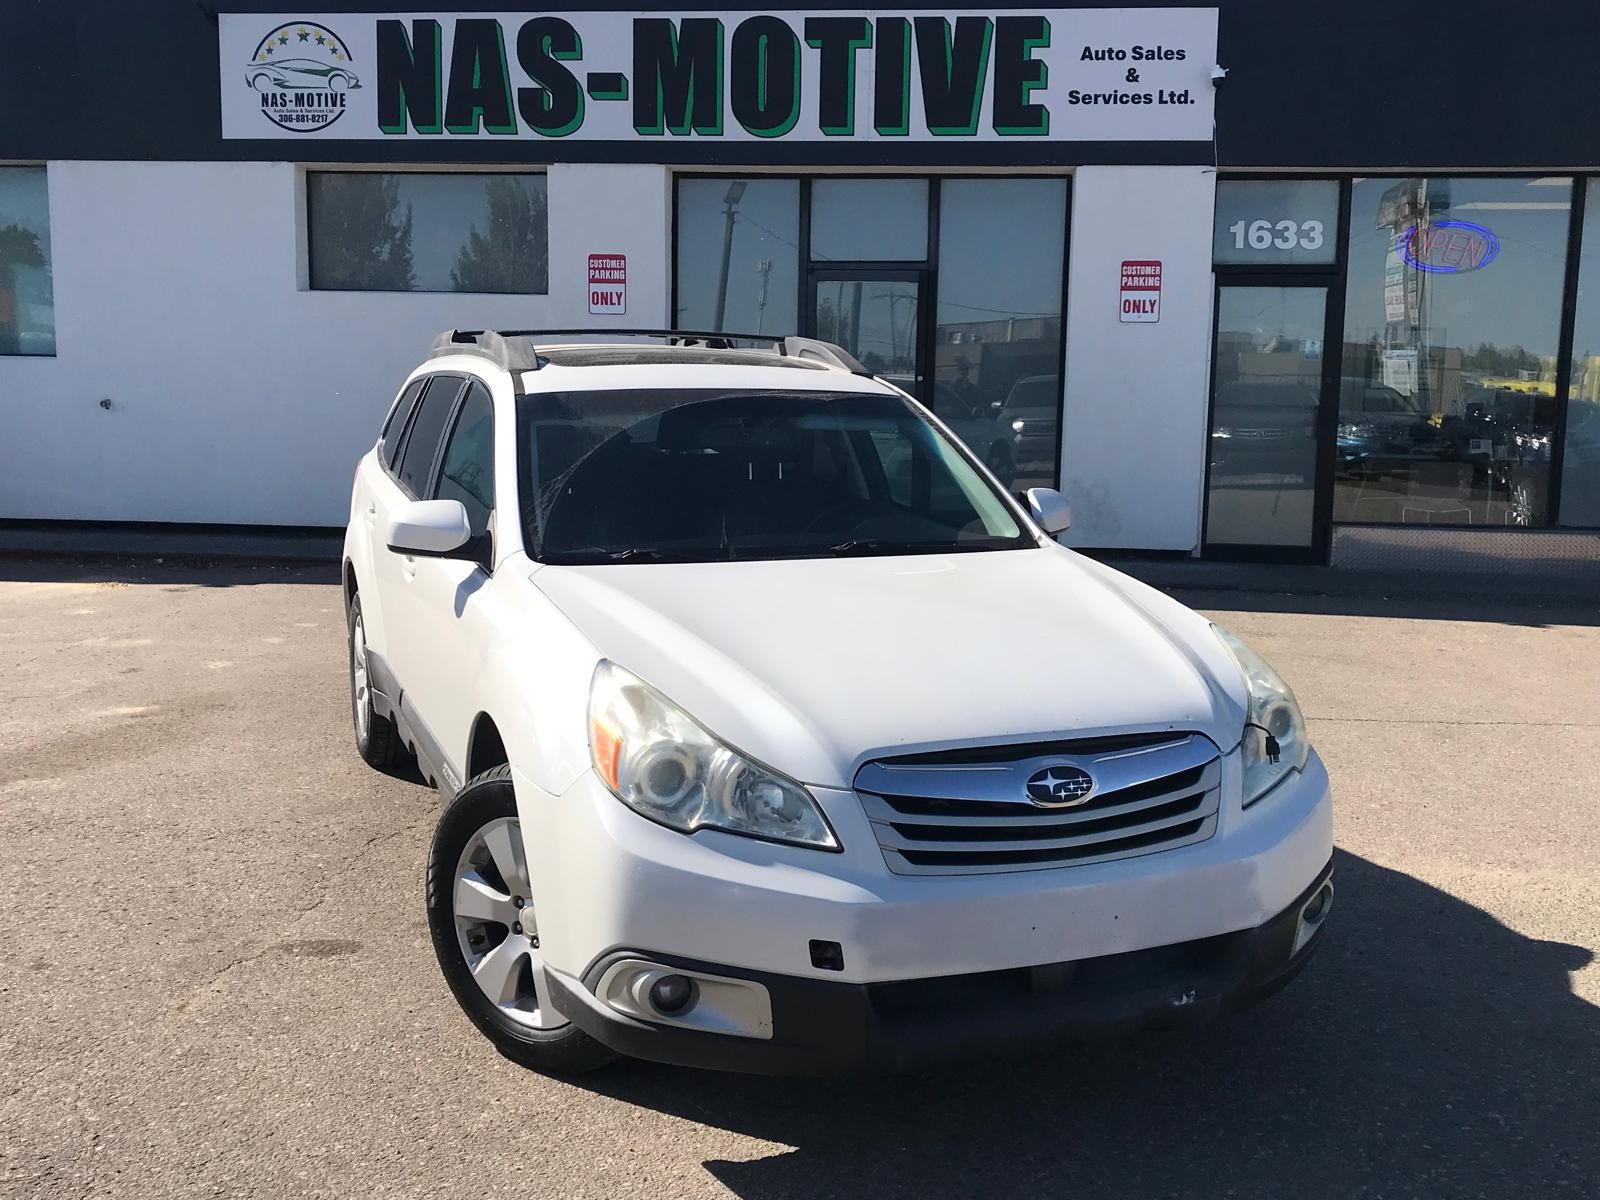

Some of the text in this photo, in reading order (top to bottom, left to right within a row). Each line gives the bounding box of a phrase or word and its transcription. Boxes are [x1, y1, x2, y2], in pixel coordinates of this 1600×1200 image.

[1080, 45, 1186, 61] Auto Sales
[376, 15, 1051, 138] NAS-MOTIVE
[1125, 67, 1140, 82] &
[261, 92, 346, 108] NAS-MOTIVE
[1068, 89, 1195, 105] Services Ltd.
[278, 114, 328, 123] 306-881-8217
[1229, 219, 1324, 250] 1633
[1407, 226, 1486, 268] OPEN
[589, 259, 625, 268] CUSTOMER
[1122, 265, 1161, 275] CUSTOMER
[589, 269, 625, 280] PARKING
[1121, 276, 1160, 287] PARKING
[591, 291, 623, 306] ONLY
[1123, 299, 1157, 314] ONLY
